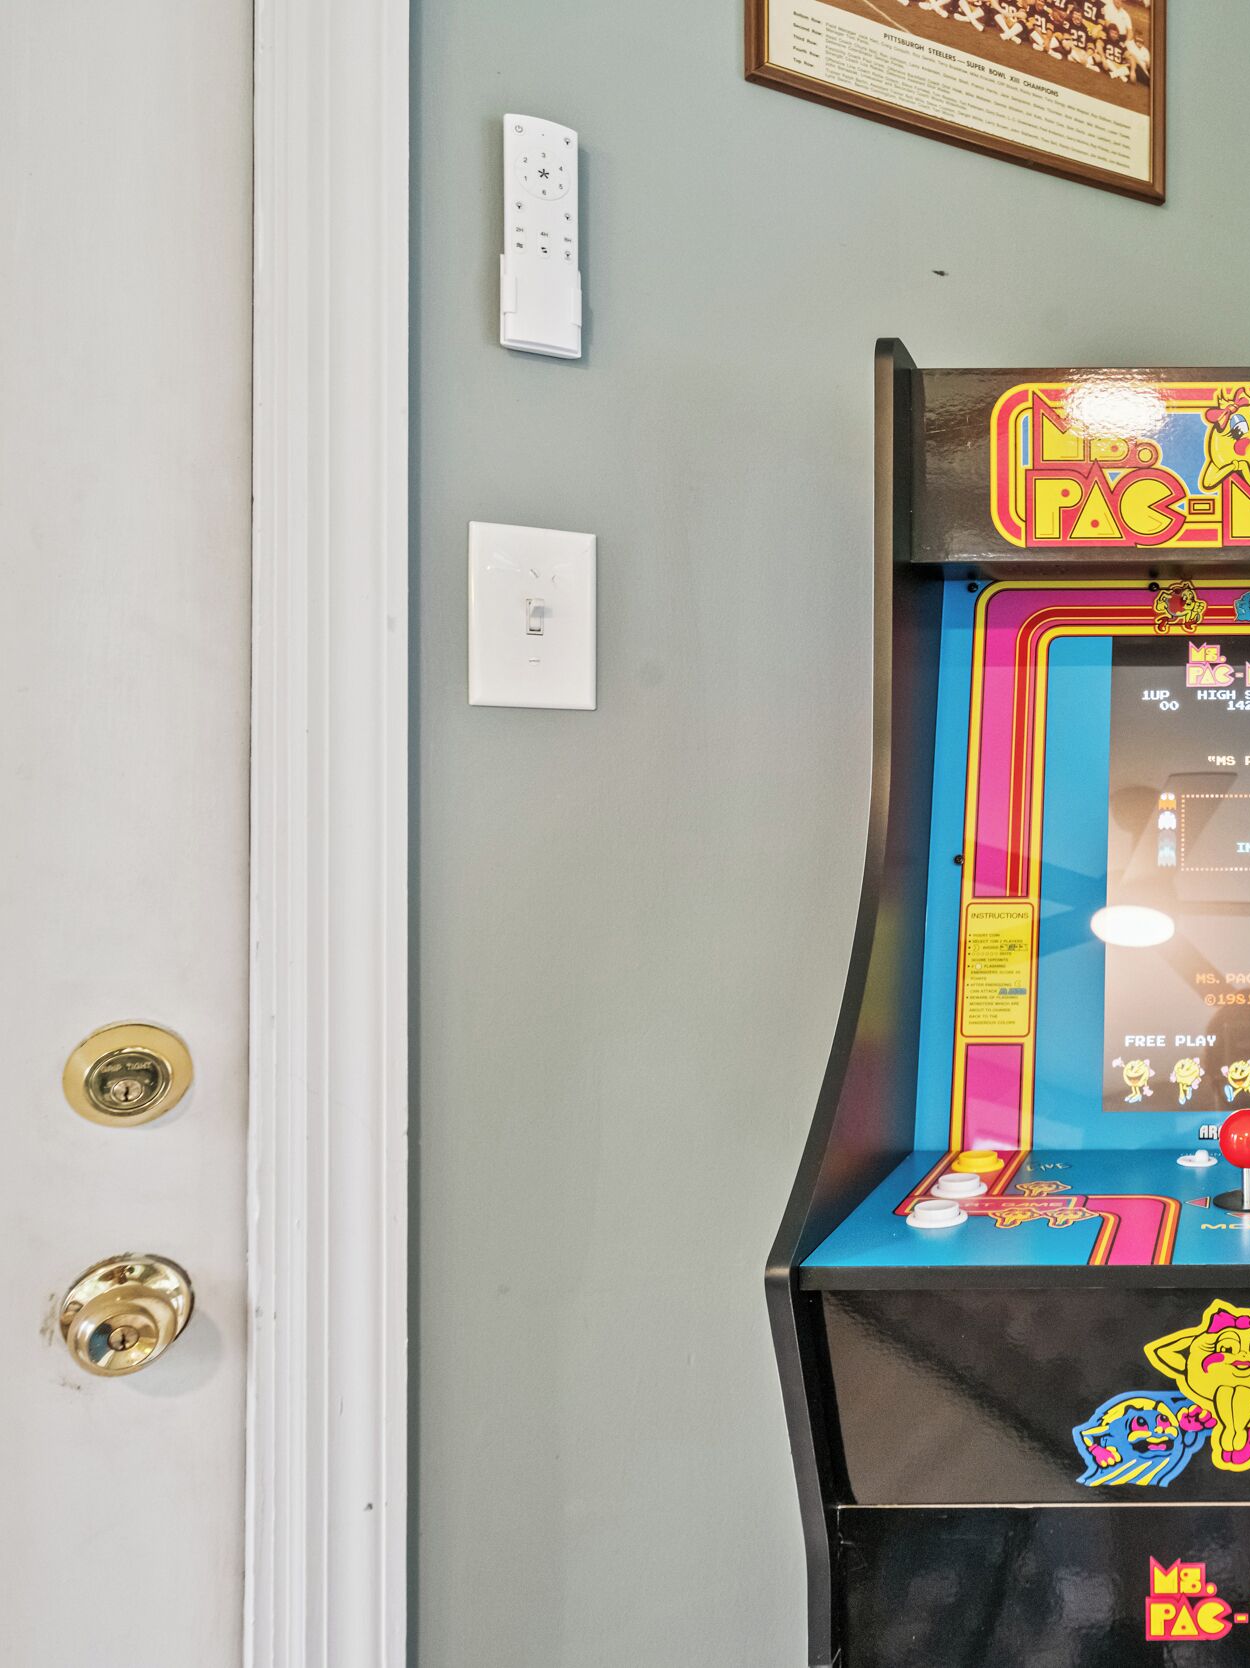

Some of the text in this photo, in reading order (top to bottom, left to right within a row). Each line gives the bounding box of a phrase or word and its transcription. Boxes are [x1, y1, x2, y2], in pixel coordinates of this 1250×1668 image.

[1083, 1, 1097, 20] 51
[1070, 29, 1086, 47] 23
[1106, 44, 1122, 63] 25
[883, 33, 924, 50] PITTSBURGH
[989, 69, 1006, 79] BOWL
[1023, 81, 1058, 97] CHAMPIONS
[1142, 690, 1170, 700] 1UP
[1197, 690, 1236, 700] HIGH
[1159, 701, 1179, 711] 00
[1196, 973, 1220, 984] MS.
[1125, 1035, 1216, 1047] FREE PLAY
